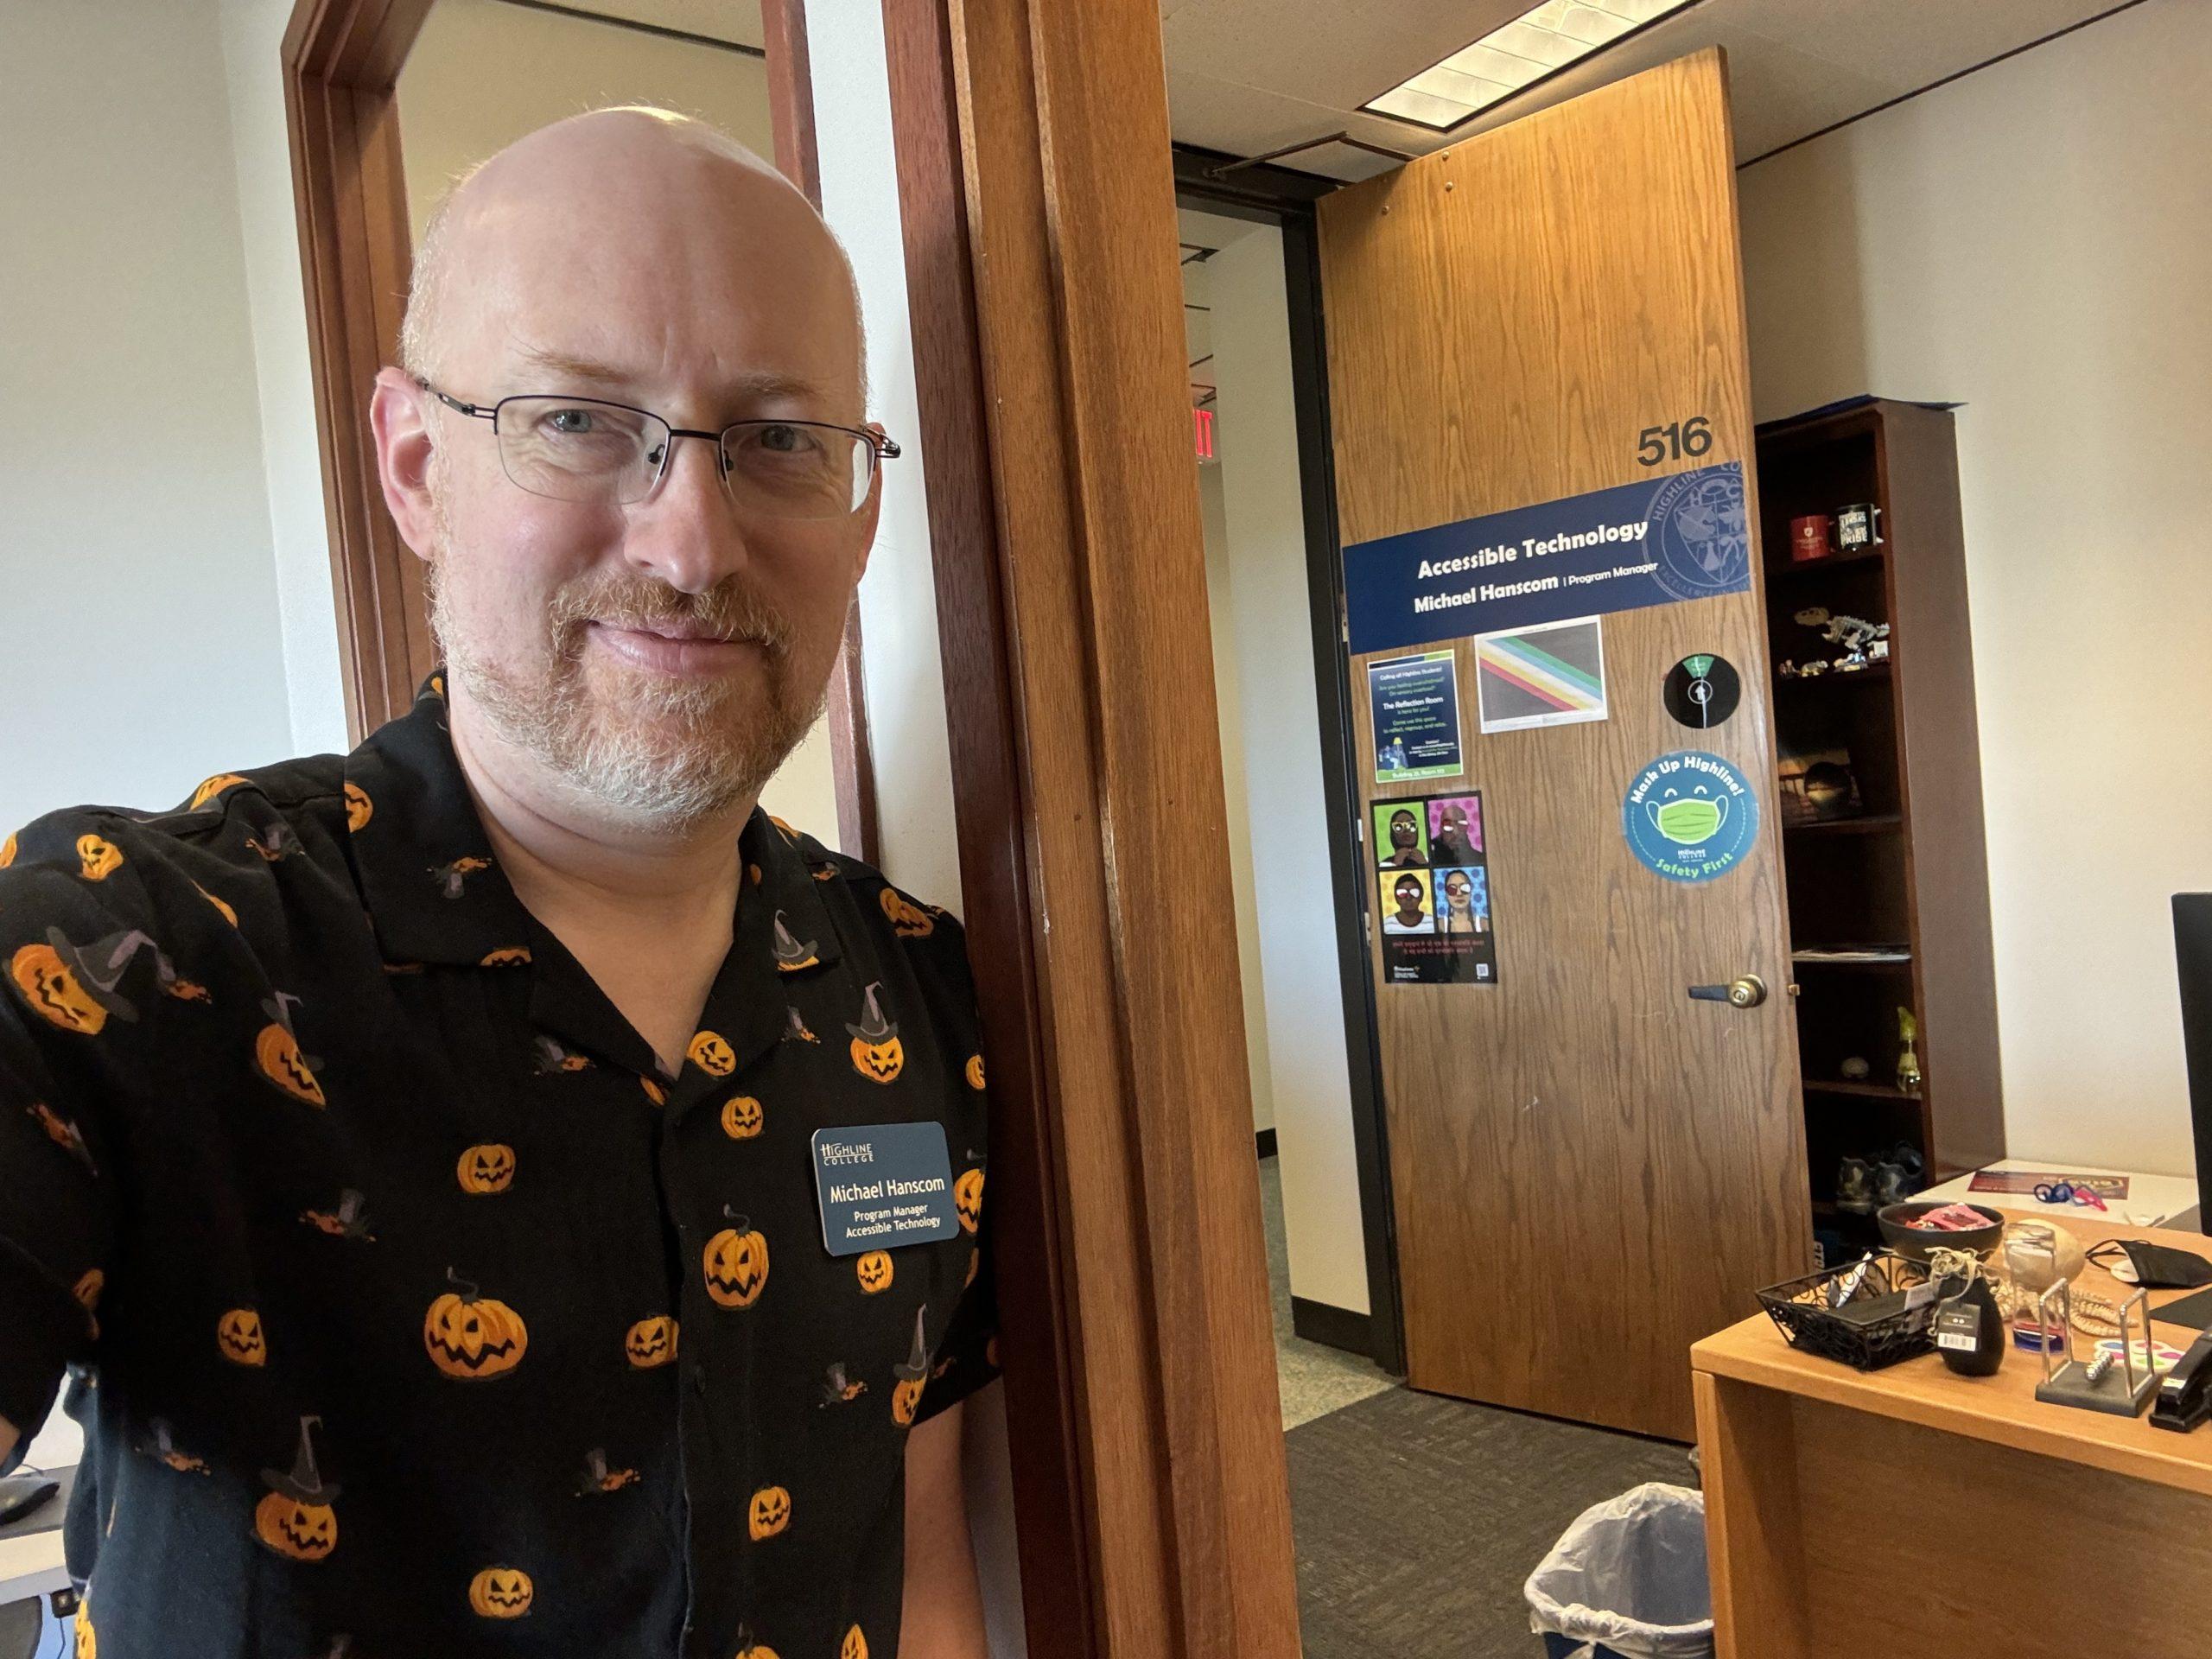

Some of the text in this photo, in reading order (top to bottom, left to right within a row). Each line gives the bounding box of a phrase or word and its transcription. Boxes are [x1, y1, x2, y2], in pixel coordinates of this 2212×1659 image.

[1637, 416, 1713, 467] 516
[1418, 521, 1649, 580] Accessible Technology
[1414, 588, 1477, 613] Michael
[1480, 576, 1559, 602] Hanscom
[1568, 569, 1611, 586] Program
[1612, 563, 1658, 577] Manager
[1395, 700, 1425, 709] Reflection
[1630, 756, 1745, 804] Mask Up Highline!
[1656, 853, 1733, 878] Safety First
[820, 1142, 873, 1156] HIGHLINE
[823, 1154, 874, 1166] COLLEGE
[830, 1178, 945, 1204] Michael Hanscom
[855, 1205, 928, 1223] Program Manager
[846, 1216, 941, 1238] Accessible Technology
